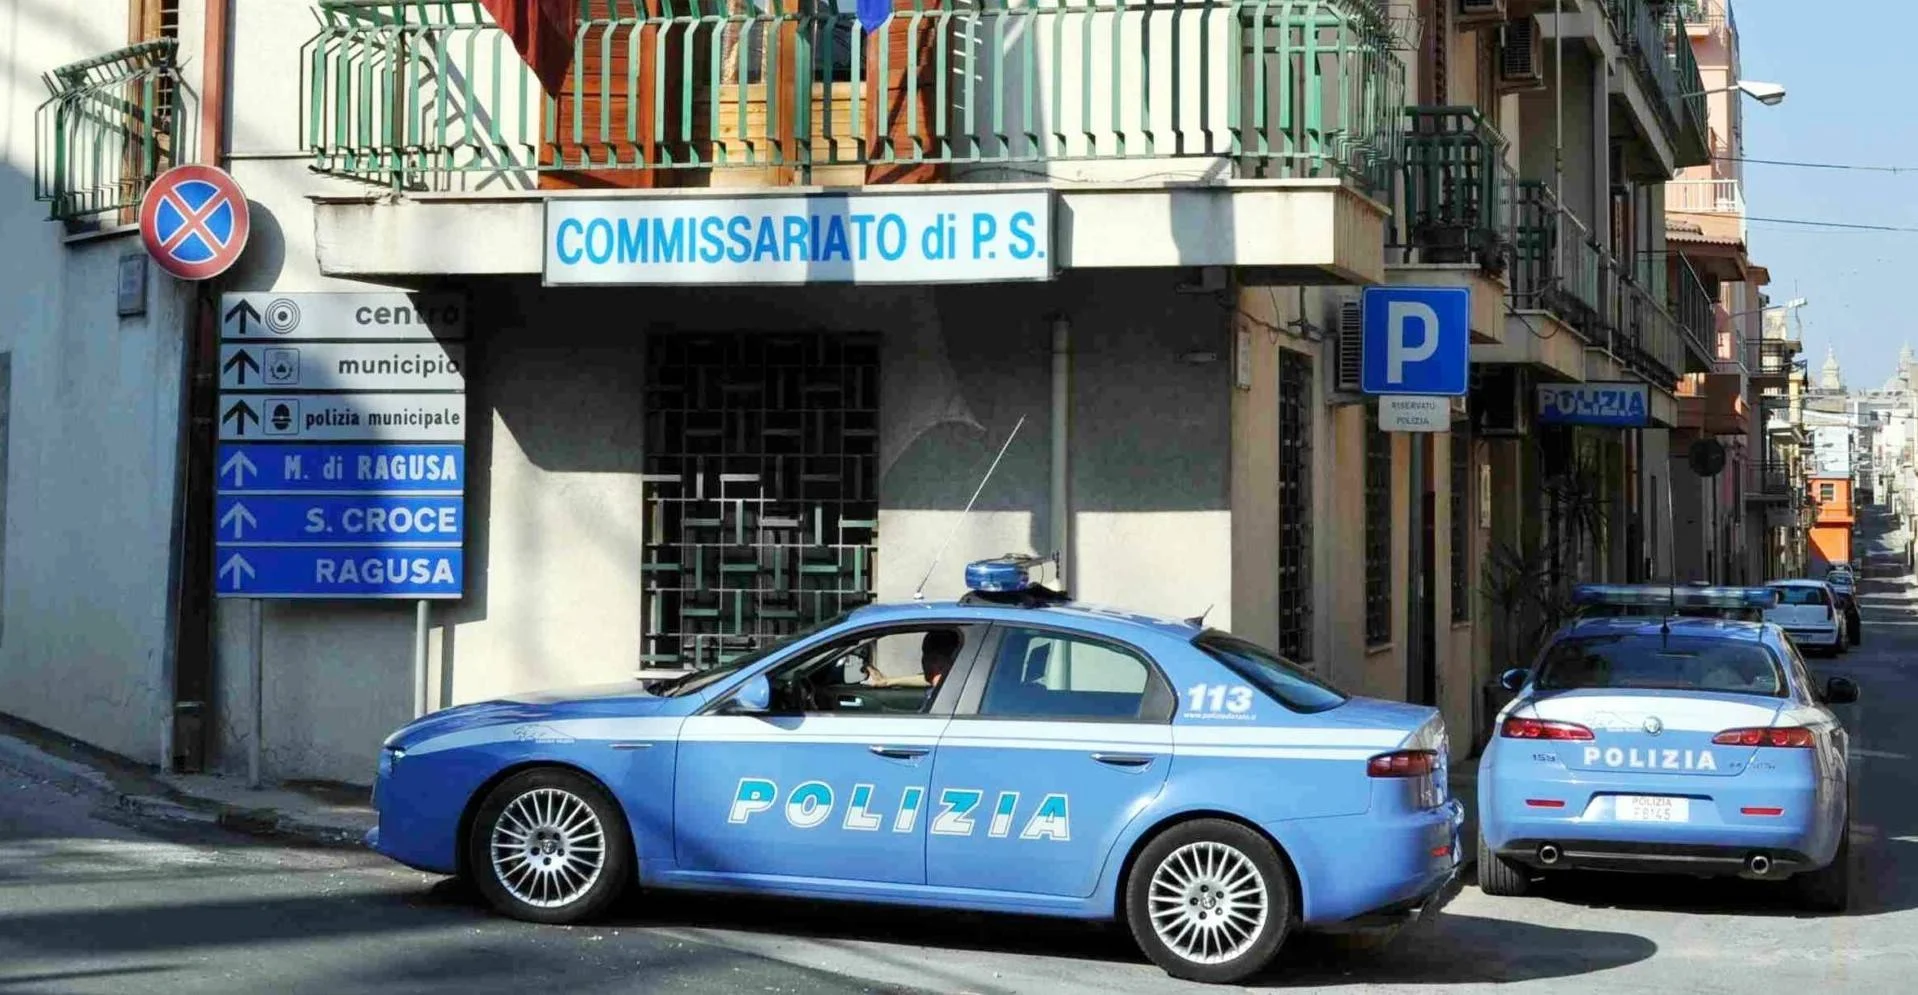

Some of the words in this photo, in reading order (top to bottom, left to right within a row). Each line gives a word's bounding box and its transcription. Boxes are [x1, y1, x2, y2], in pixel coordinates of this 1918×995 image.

[556, 213, 907, 265] COMMISSARIATO
[921, 213, 956, 260] di
[972, 212, 997, 260] P.
[1008, 211, 1046, 260] S.
[355, 302, 459, 326] centro
[1387, 301, 1439, 384] P
[338, 354, 460, 378] municipio
[1539, 389, 1645, 417] POLIZIA
[305, 408, 360, 430] polizia
[368, 408, 461, 429] municipale
[284, 455, 309, 480] M.
[323, 455, 343, 480] di
[357, 454, 457, 481] RAGUSA
[304, 507, 333, 533] S.
[342, 507, 457, 533] CROCE
[316, 558, 455, 584] RAGUSA
[1187, 683, 1254, 713] 113
[1584, 746, 1718, 770] POLIZIA
[727, 777, 1071, 842] POLIZIA
[1632, 796, 1673, 807] POLIZIA
